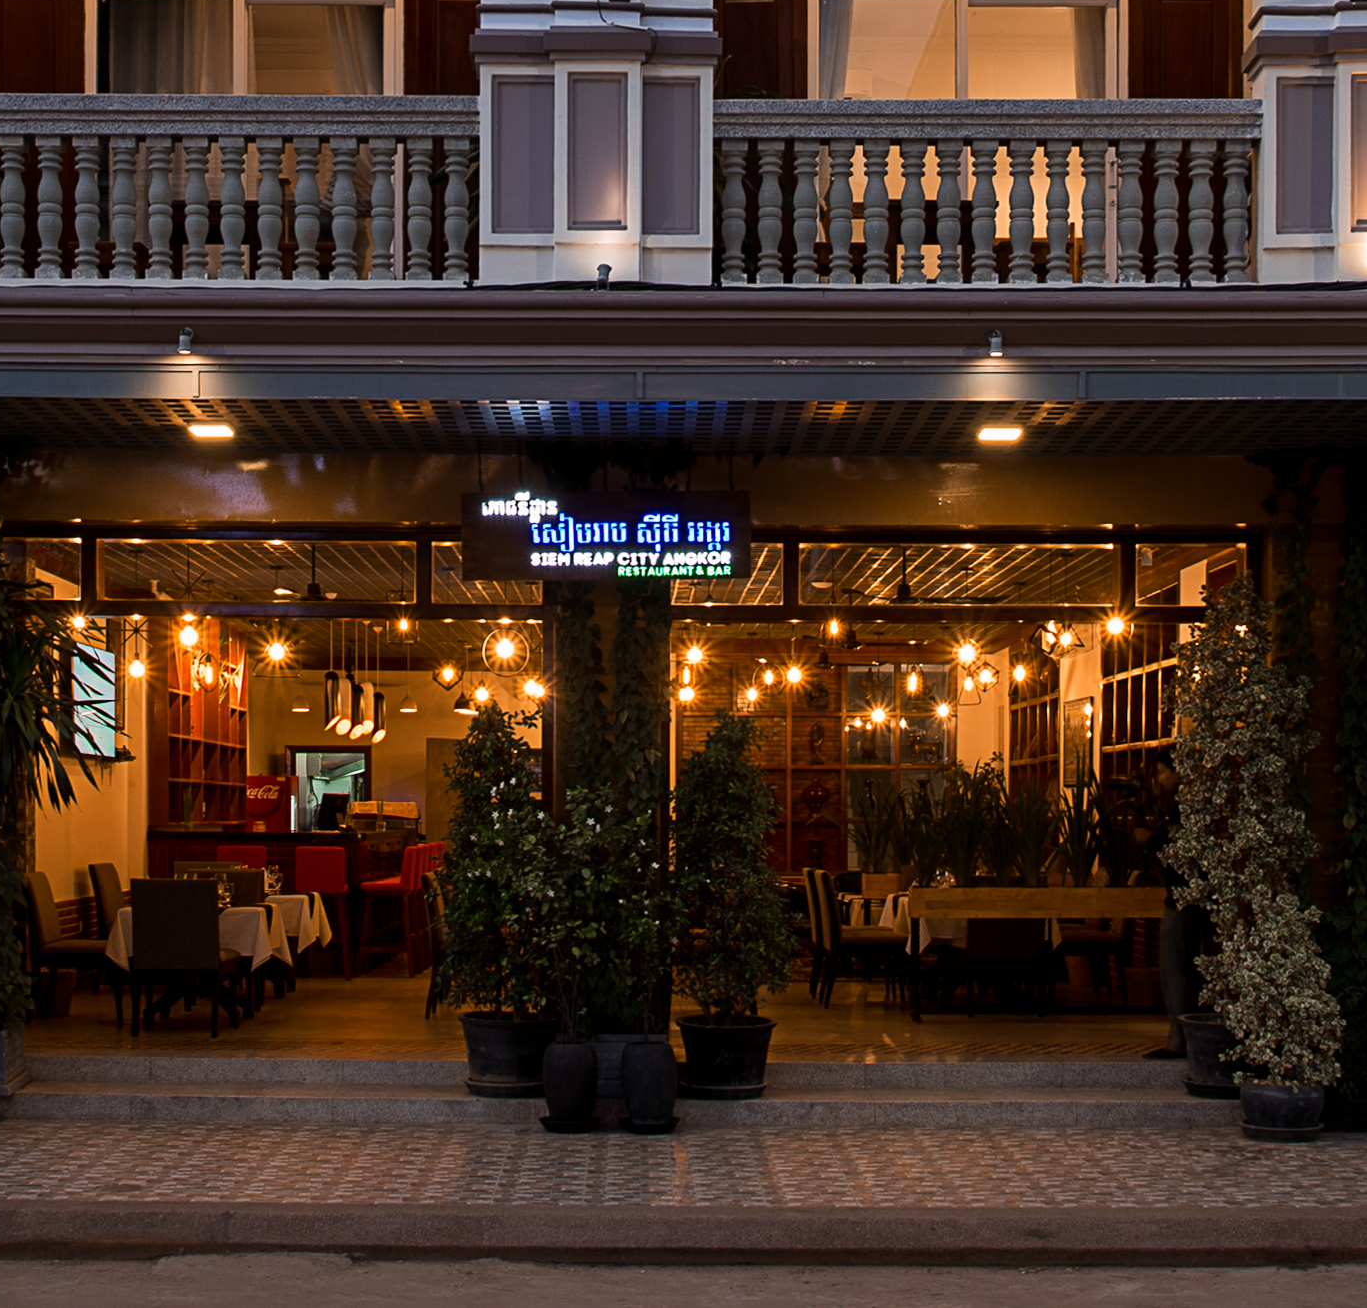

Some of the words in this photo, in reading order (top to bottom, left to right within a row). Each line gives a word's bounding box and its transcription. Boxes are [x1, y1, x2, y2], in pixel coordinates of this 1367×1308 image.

[530, 552, 571, 567] SIEM
[573, 552, 615, 567] REAP
[617, 552, 661, 567] CITY
[662, 551, 732, 567] ANGKOR
[617, 566, 694, 577] RESTAURANT
[695, 566, 705, 577] &
[707, 566, 732, 577] BAR
